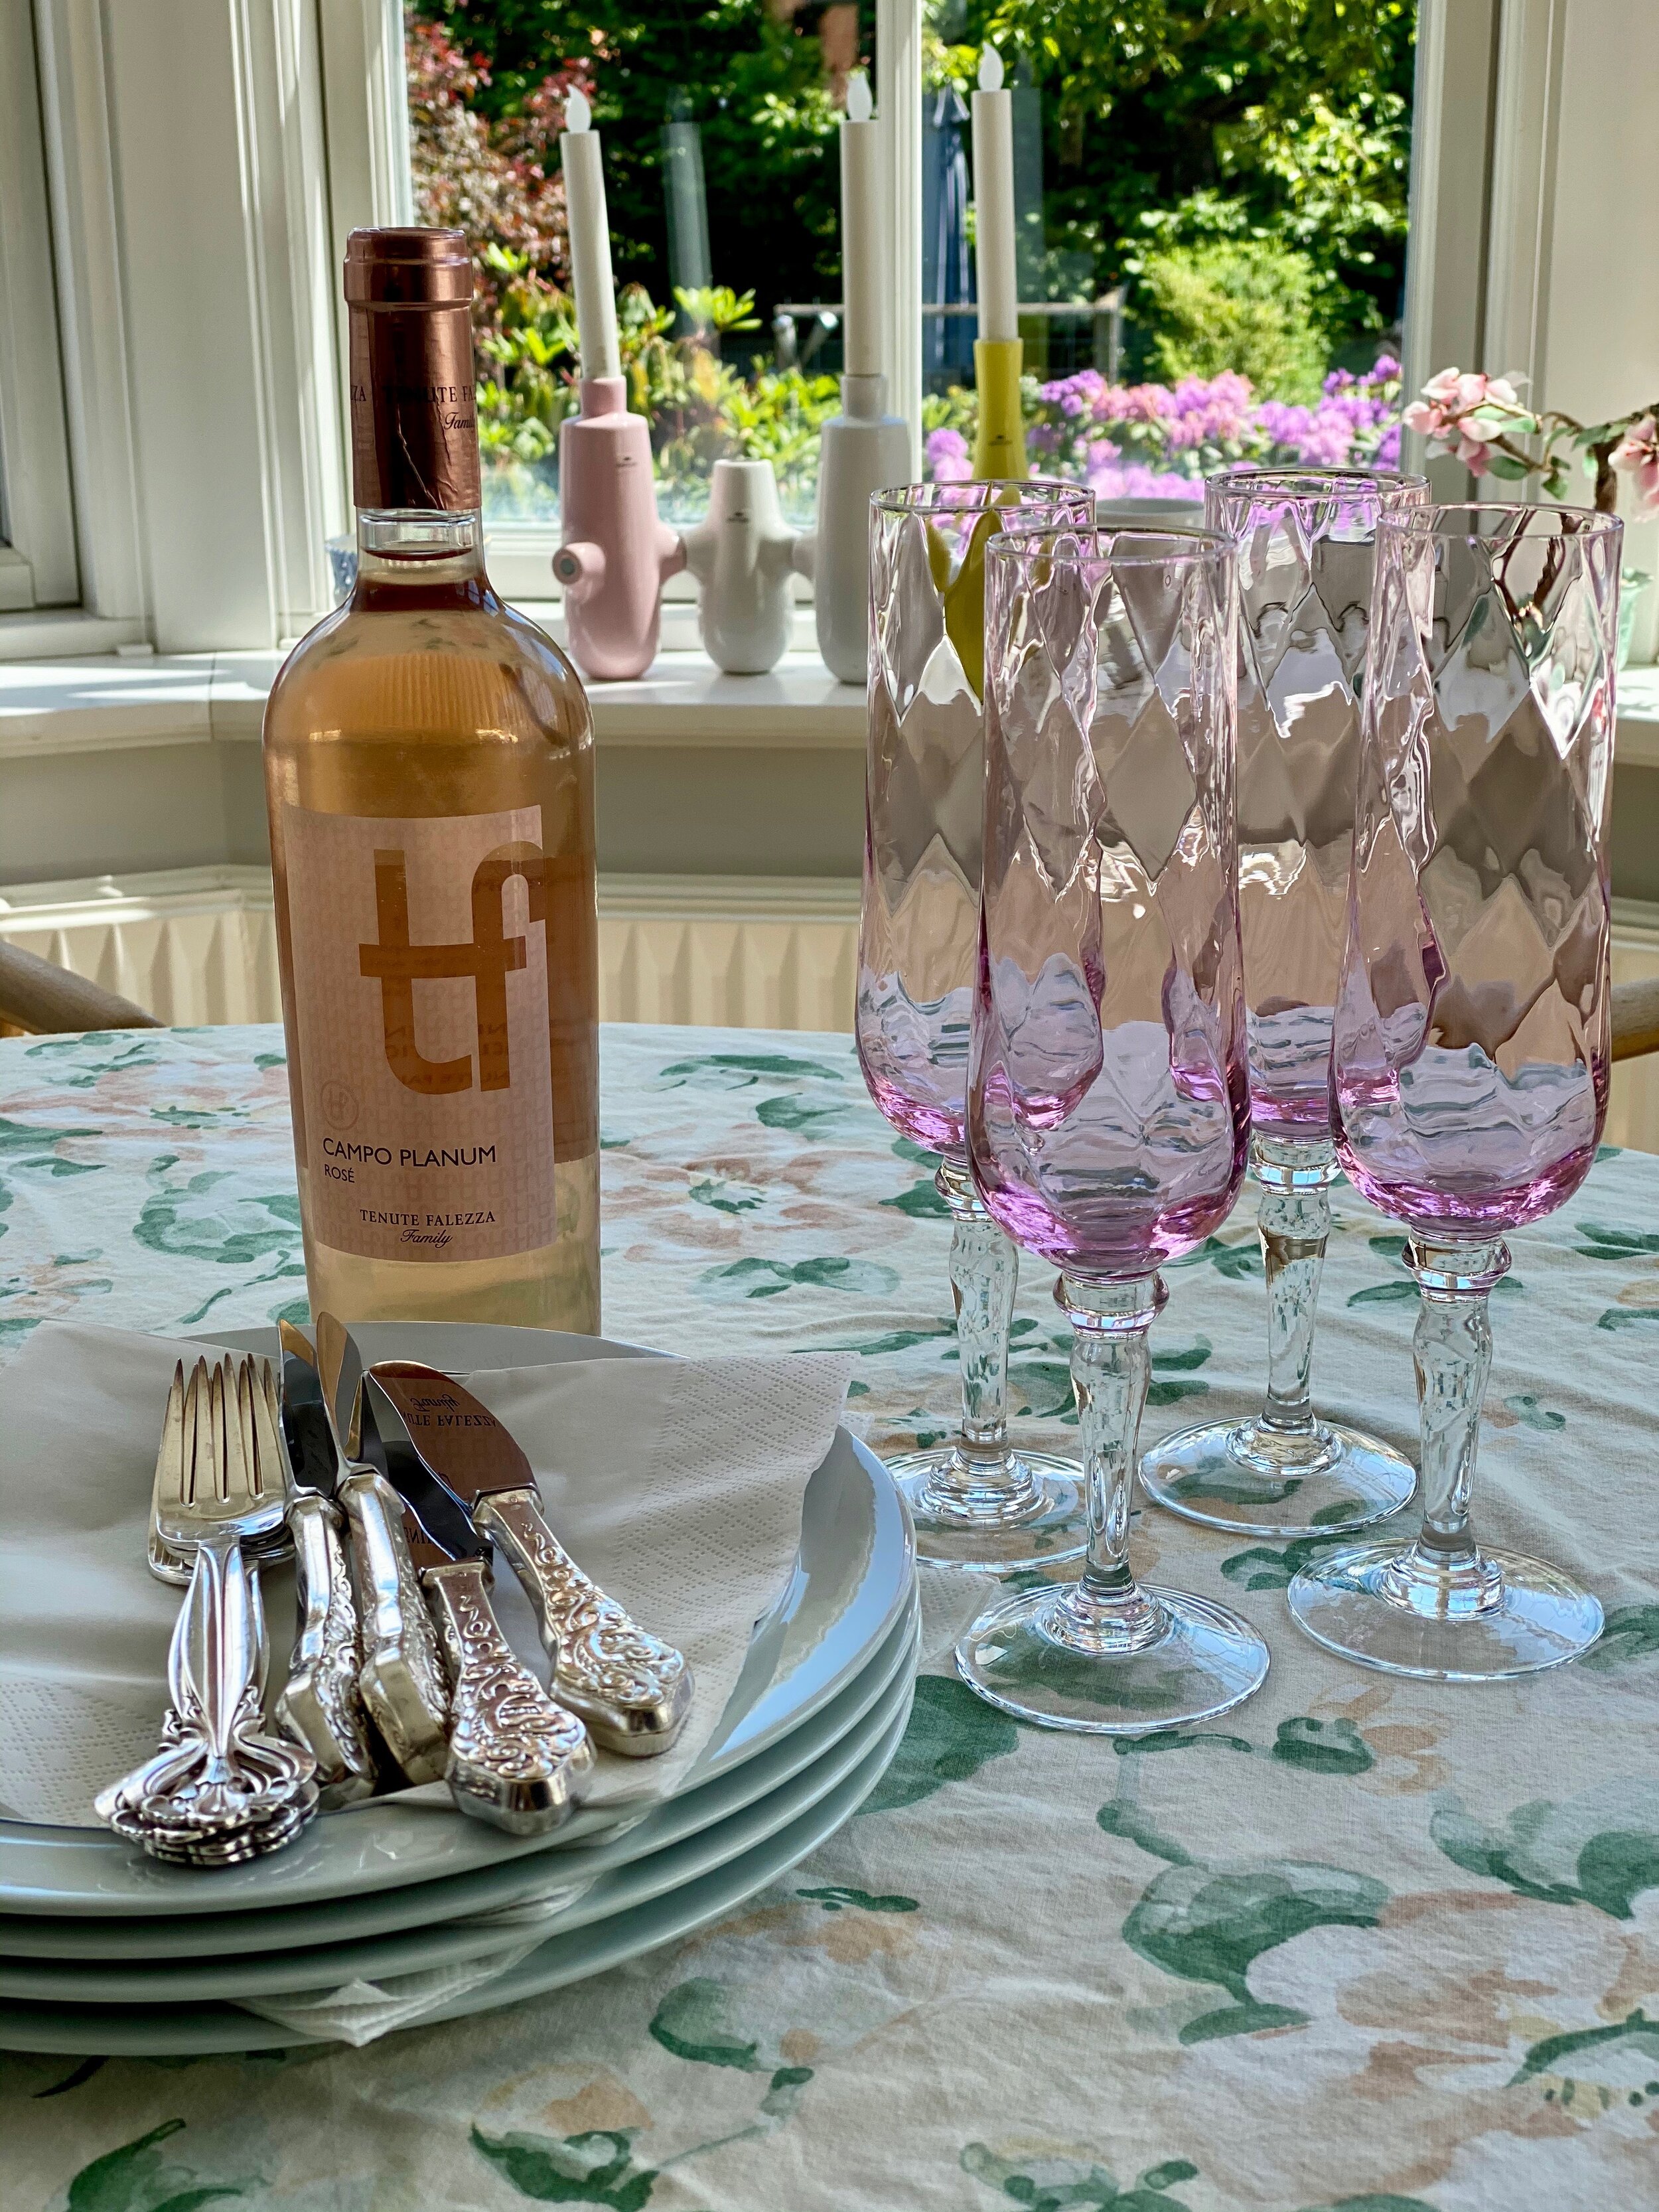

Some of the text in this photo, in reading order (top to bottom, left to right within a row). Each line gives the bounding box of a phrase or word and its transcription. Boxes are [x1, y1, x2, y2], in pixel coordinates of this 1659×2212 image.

[323, 1137, 497, 1167] CAMPO PLANUM
[324, 1163, 356, 1183] ROSÉ
[360, 1209, 496, 1227] TENUTE FALEZZA
[399, 1228, 454, 1249] Family
